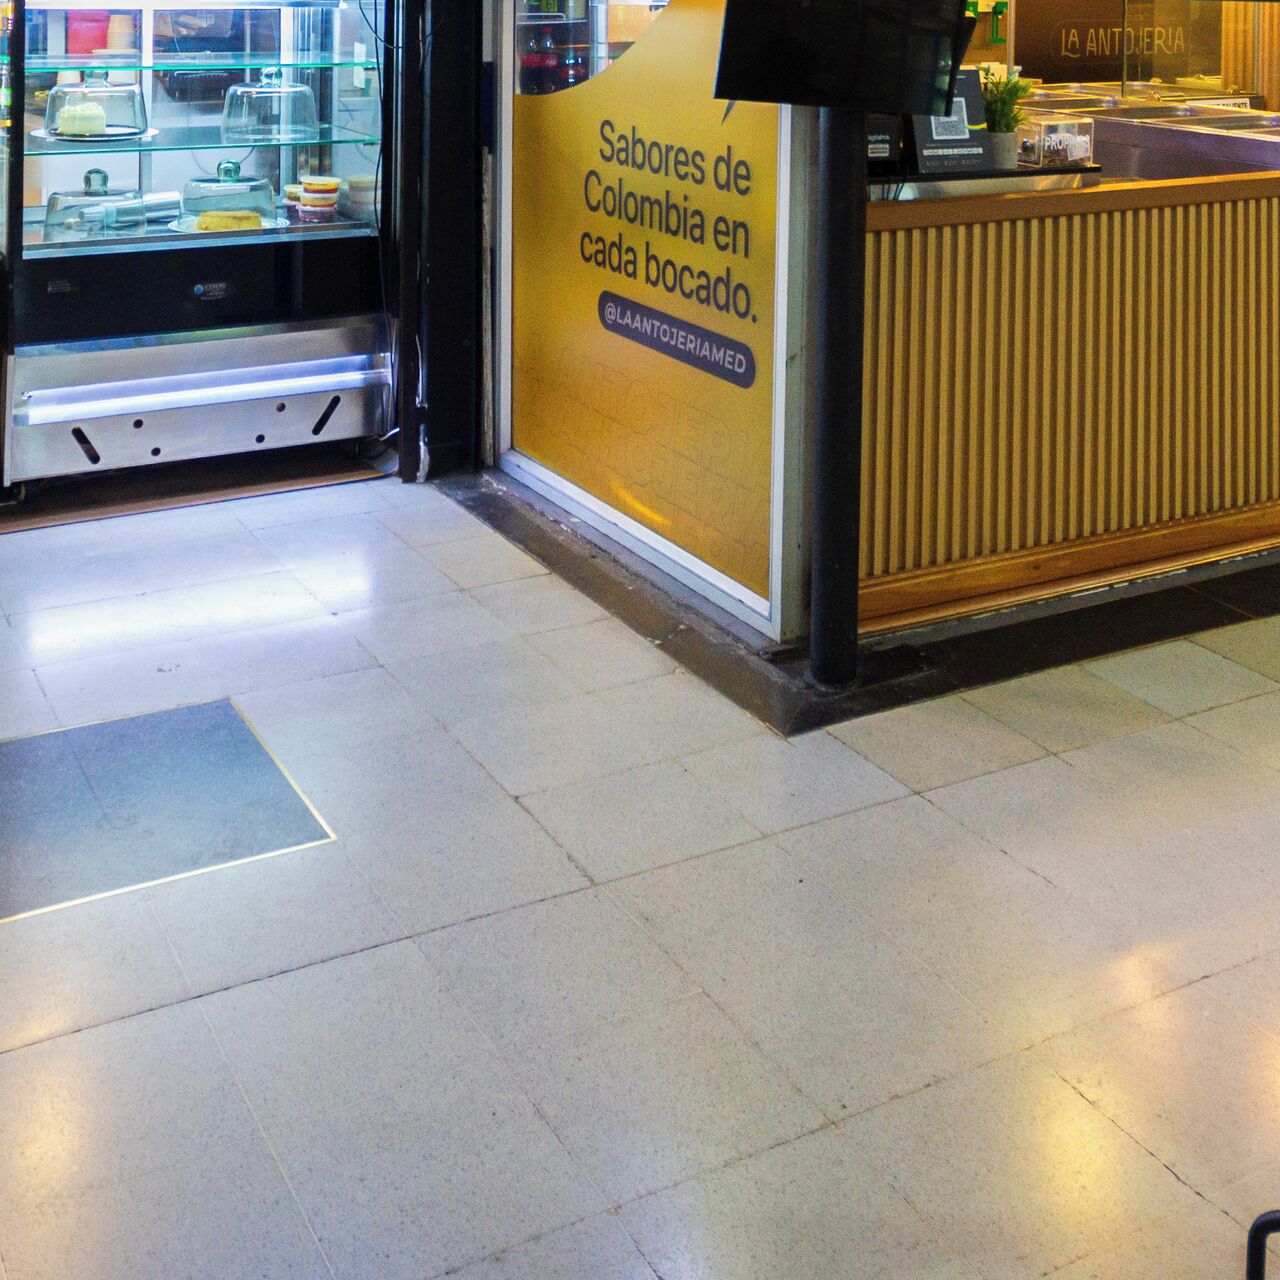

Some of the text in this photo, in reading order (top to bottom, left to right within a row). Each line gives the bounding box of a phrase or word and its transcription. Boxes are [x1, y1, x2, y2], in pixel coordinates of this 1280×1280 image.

[1060, 26, 1186, 59] LA ANTOJERIA
[598, 118, 752, 196] Sabores de
[583, 169, 750, 259] Colombia en
[579, 229, 758, 325] cada bocado.
[603, 301, 747, 375] @LAANTOJERIAMED
